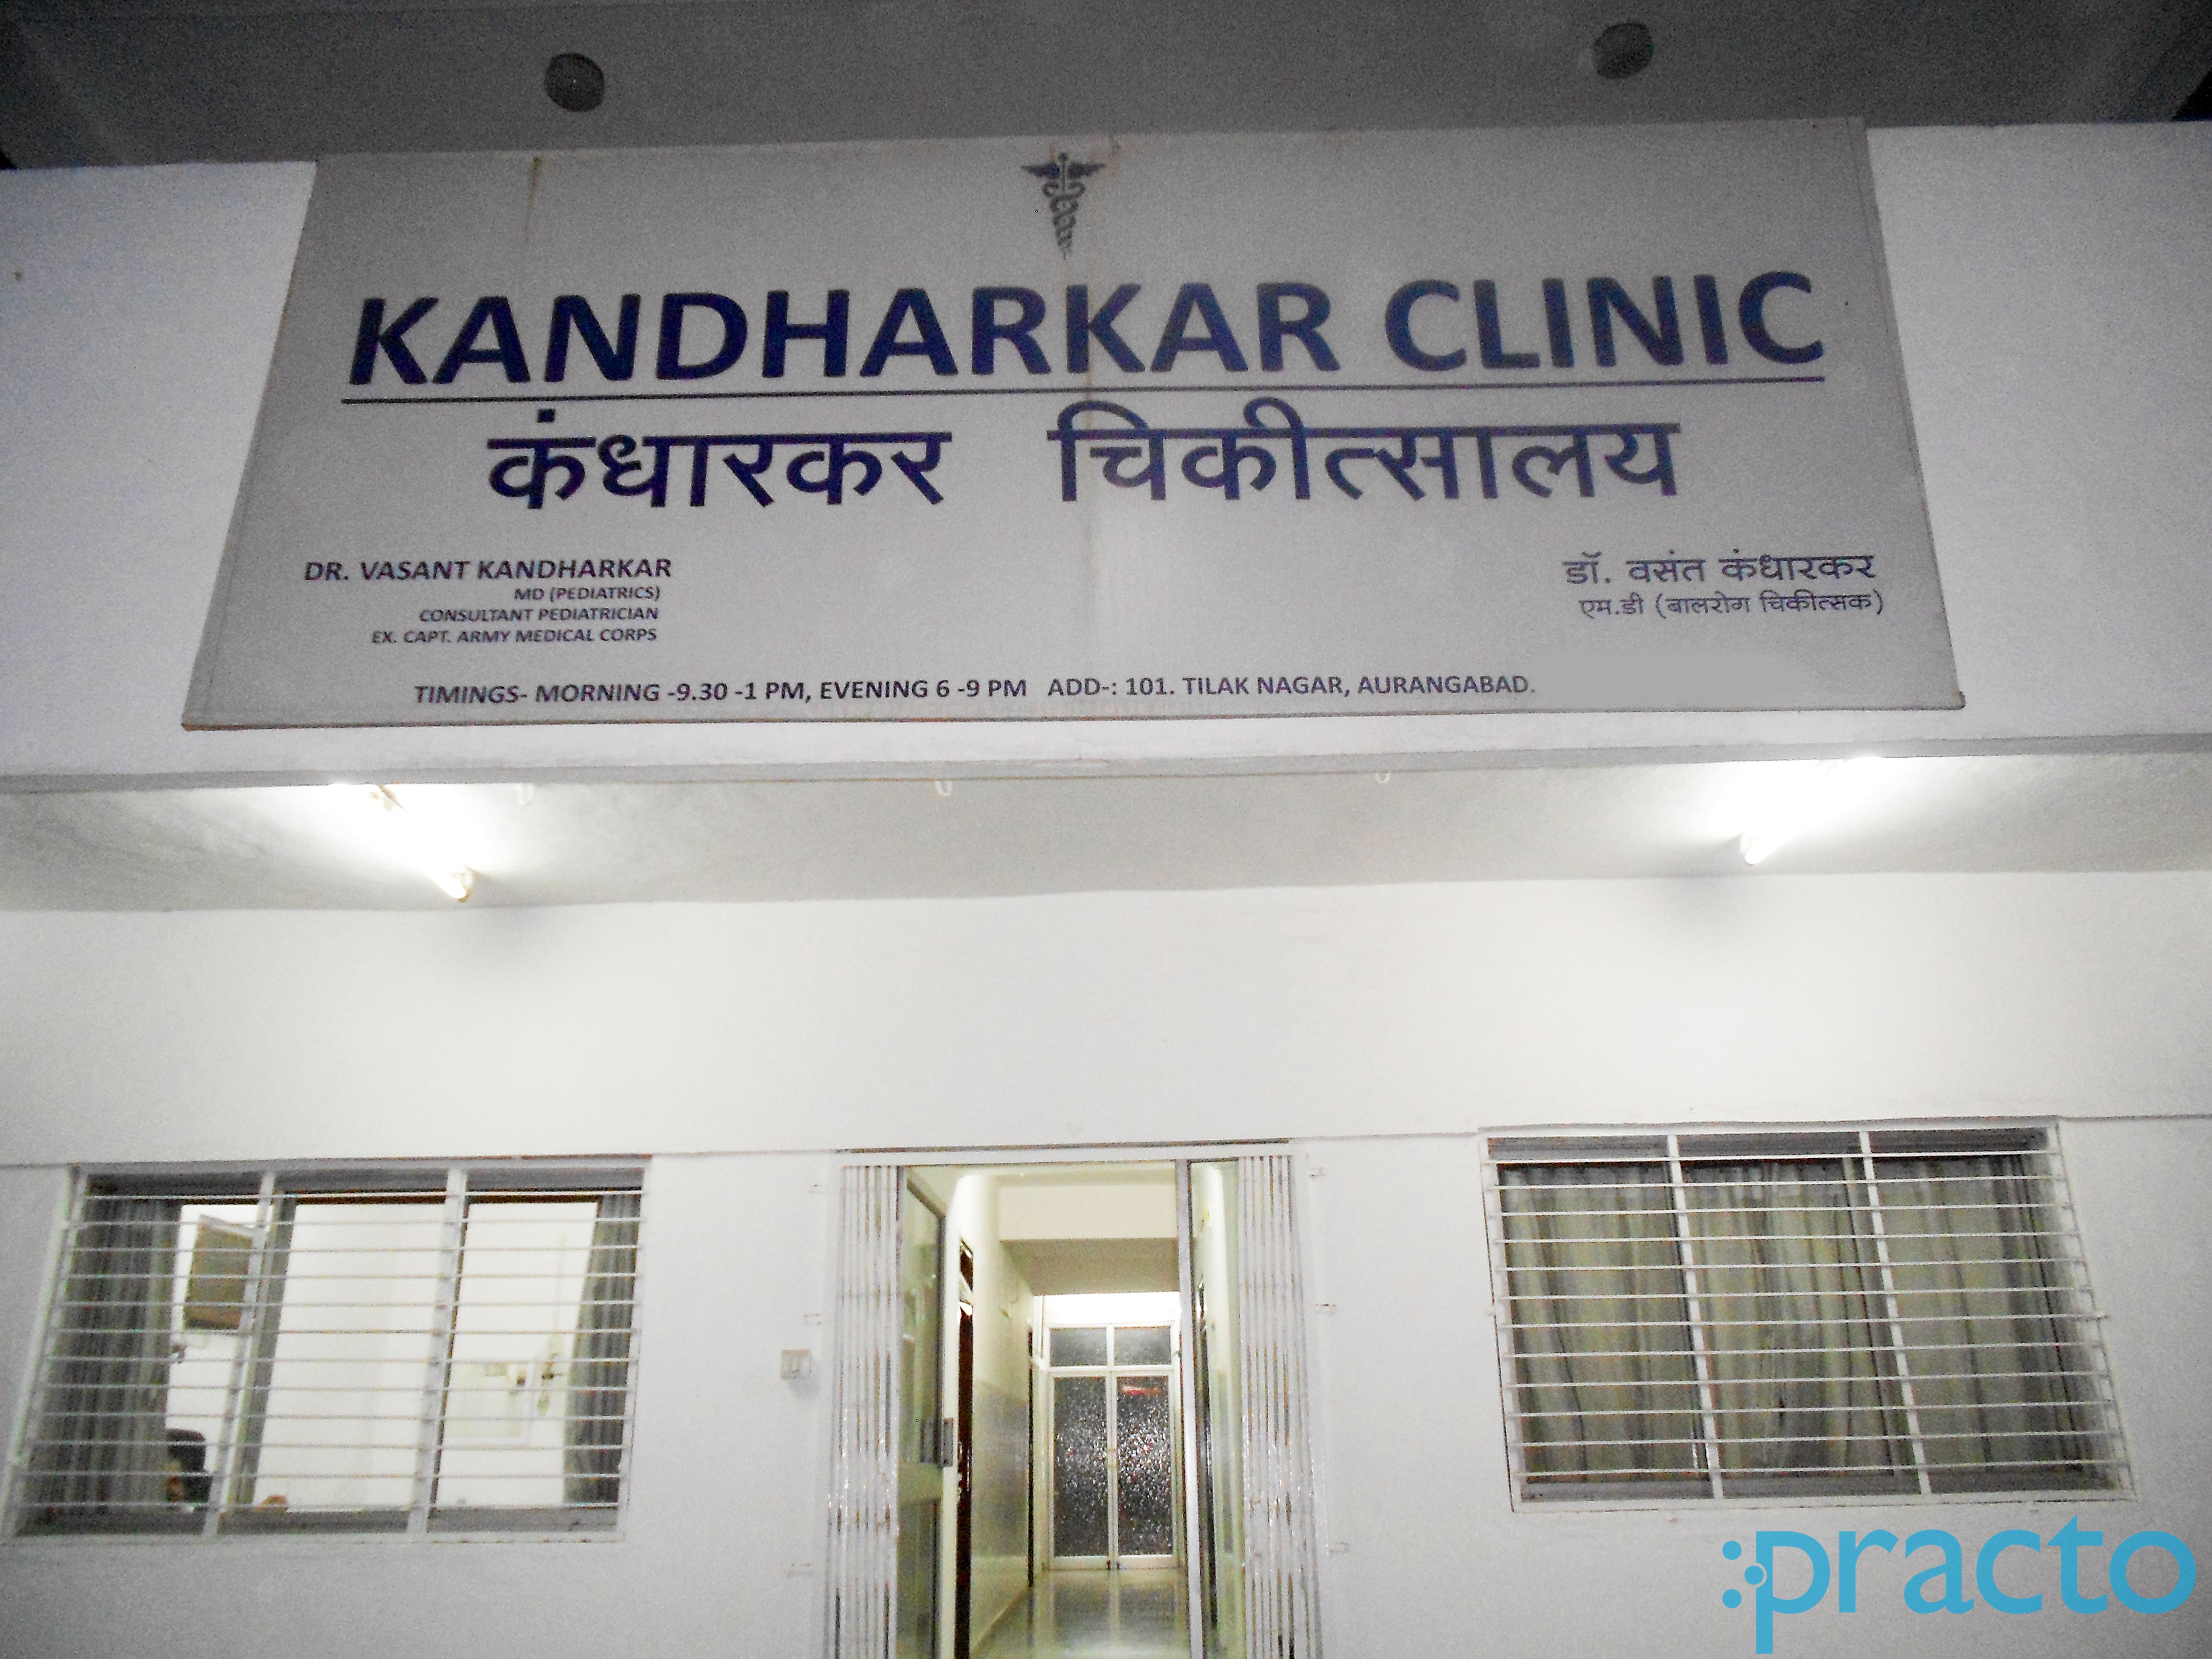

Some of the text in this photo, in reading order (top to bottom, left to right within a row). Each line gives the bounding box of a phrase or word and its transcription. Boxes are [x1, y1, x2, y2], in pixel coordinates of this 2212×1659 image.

[349, 271, 1823, 385] KANDHARKAR CLINIC
[486, 397, 1681, 509] कंधारकर चिकीत्सालय
[305, 559, 671, 580] DR. VASANT KANDHARKAR
[1562, 548, 1876, 584] डॉ. वसंत कंधारकर
[515, 586, 660, 602] MD (PEDIATRICS)
[1655, 591, 1750, 619] (बालरोग
[419, 608, 658, 622] CONSULTANT PEDIATRICIAN
[372, 629, 656, 643] EX. CAPT. ARMY MEDICAL CORPS
[415, 676, 1535, 704] TIMINGS- MORNING -9.30 -1 PM, EVENING 6 -9 PM ADD-: 101. TILAK NAGAR, AURANGABAD.
